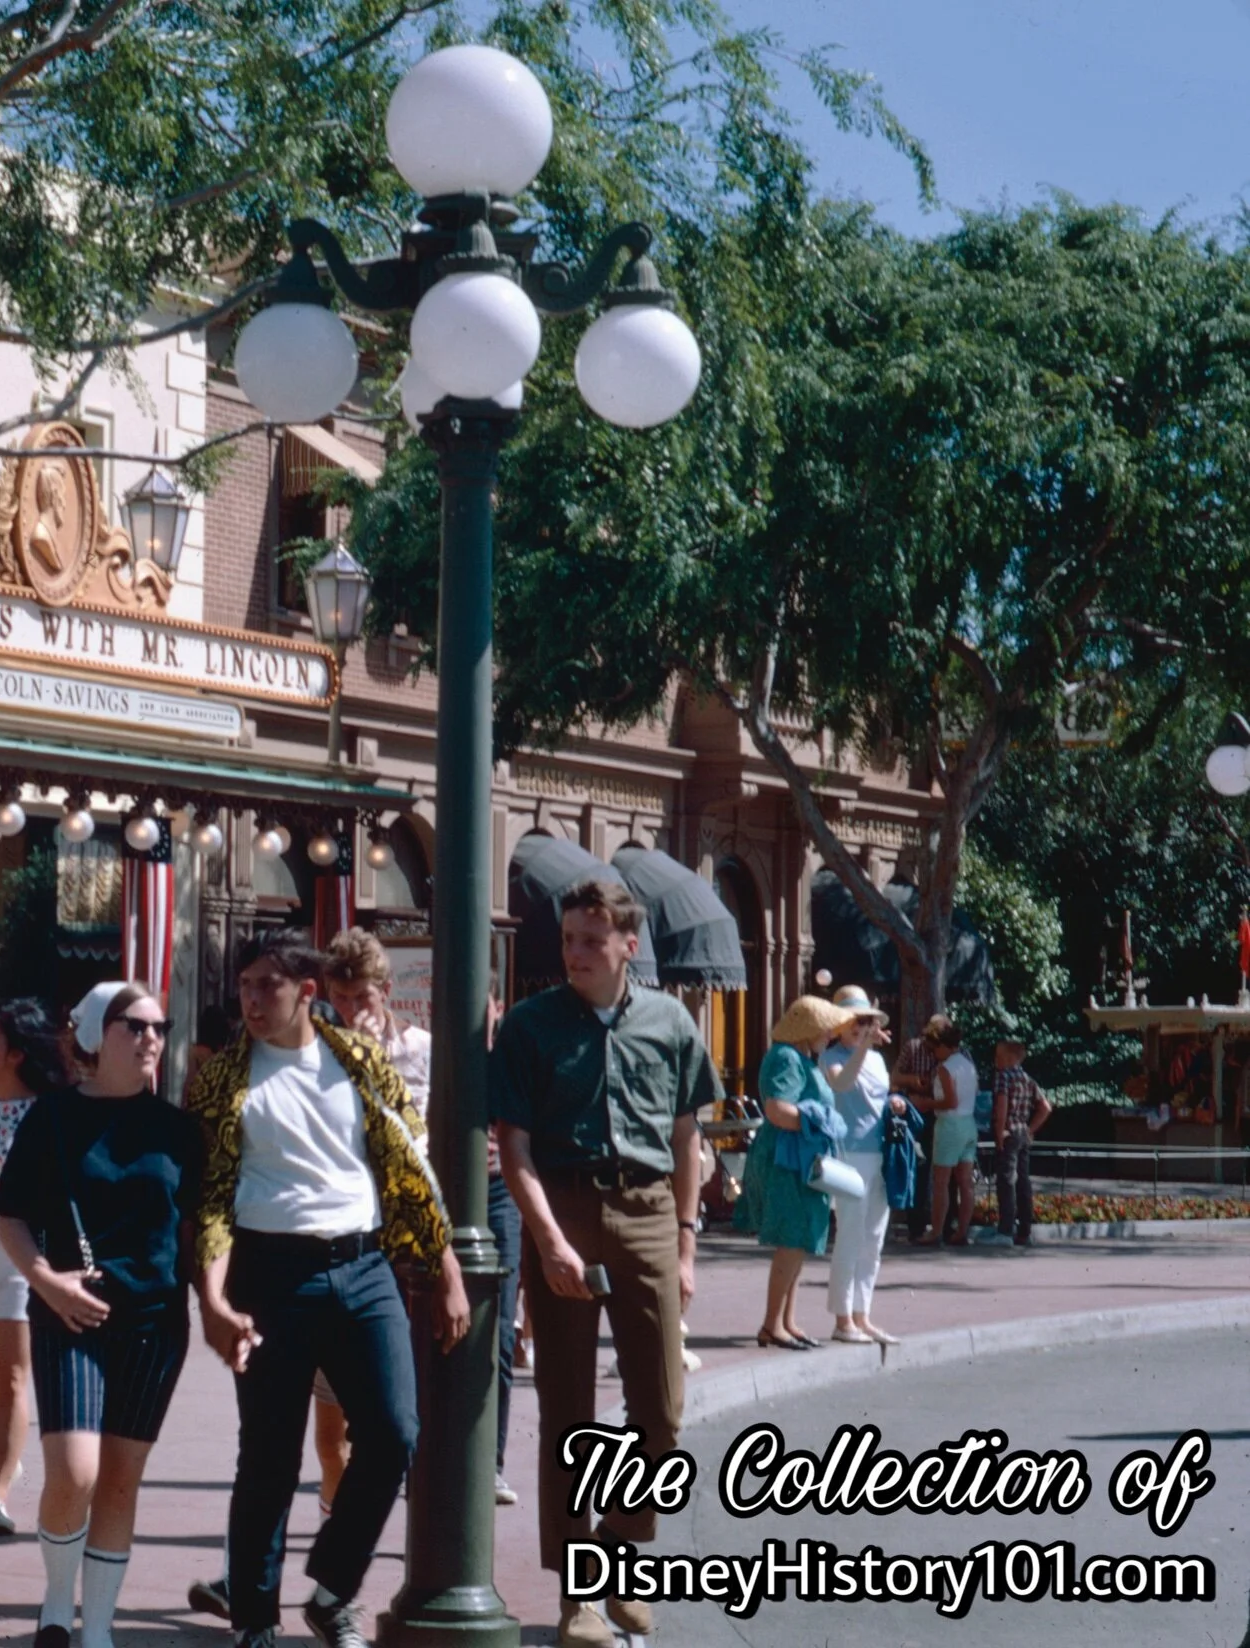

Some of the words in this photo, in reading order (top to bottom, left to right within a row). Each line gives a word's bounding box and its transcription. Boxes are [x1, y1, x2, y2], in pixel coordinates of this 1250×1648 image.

[39, 609, 116, 657] WITH
[140, 629, 184, 669] MR.
[204, 640, 310, 690] LINCOLN
[868, 819, 922, 847] AMERICA
